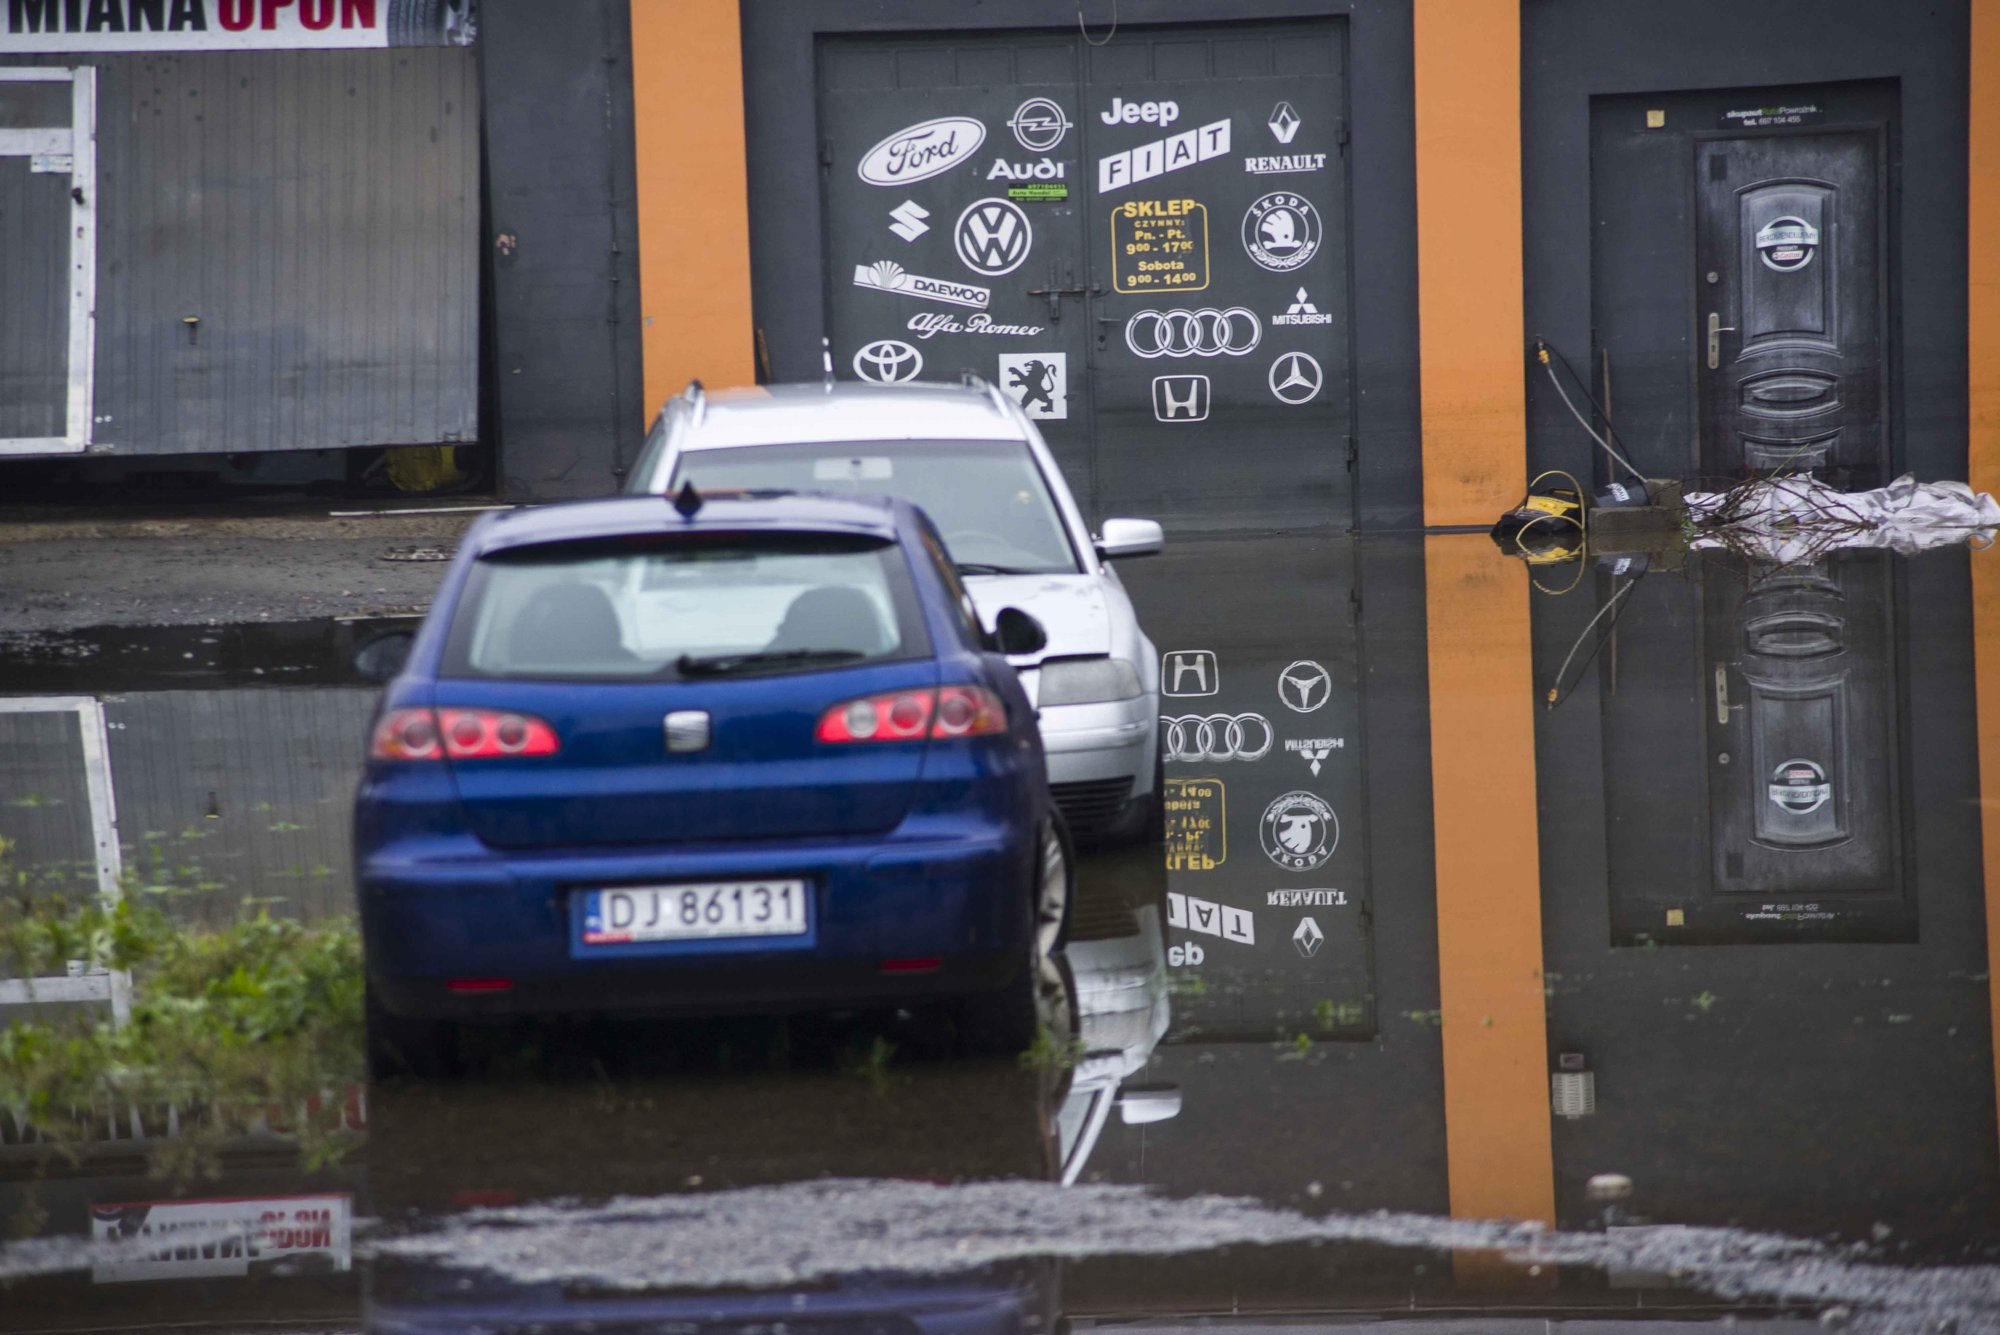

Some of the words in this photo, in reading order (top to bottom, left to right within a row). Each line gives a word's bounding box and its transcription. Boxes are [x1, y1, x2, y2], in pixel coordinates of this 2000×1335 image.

[1101, 98, 1180, 127] Jeep
[886, 130, 960, 176] Ford
[1108, 126, 1224, 186] FIAT
[1244, 153, 1326, 173] RENAULT
[986, 157, 1065, 181] Audi
[1123, 199, 1196, 218] SKLEP
[1134, 219, 1185, 228] CZYNNY:
[1135, 230, 1156, 241] Pn.
[1167, 229, 1186, 239] Pt.
[1138, 260, 1184, 271] Sobota
[913, 279, 988, 303] DAEWOO
[906, 312, 963, 340] Alfa
[964, 312, 1045, 336] Romeo
[1272, 313, 1332, 325] MITSUBISHI
[610, 892, 660, 929] DJ
[680, 886, 793, 925] 86131
